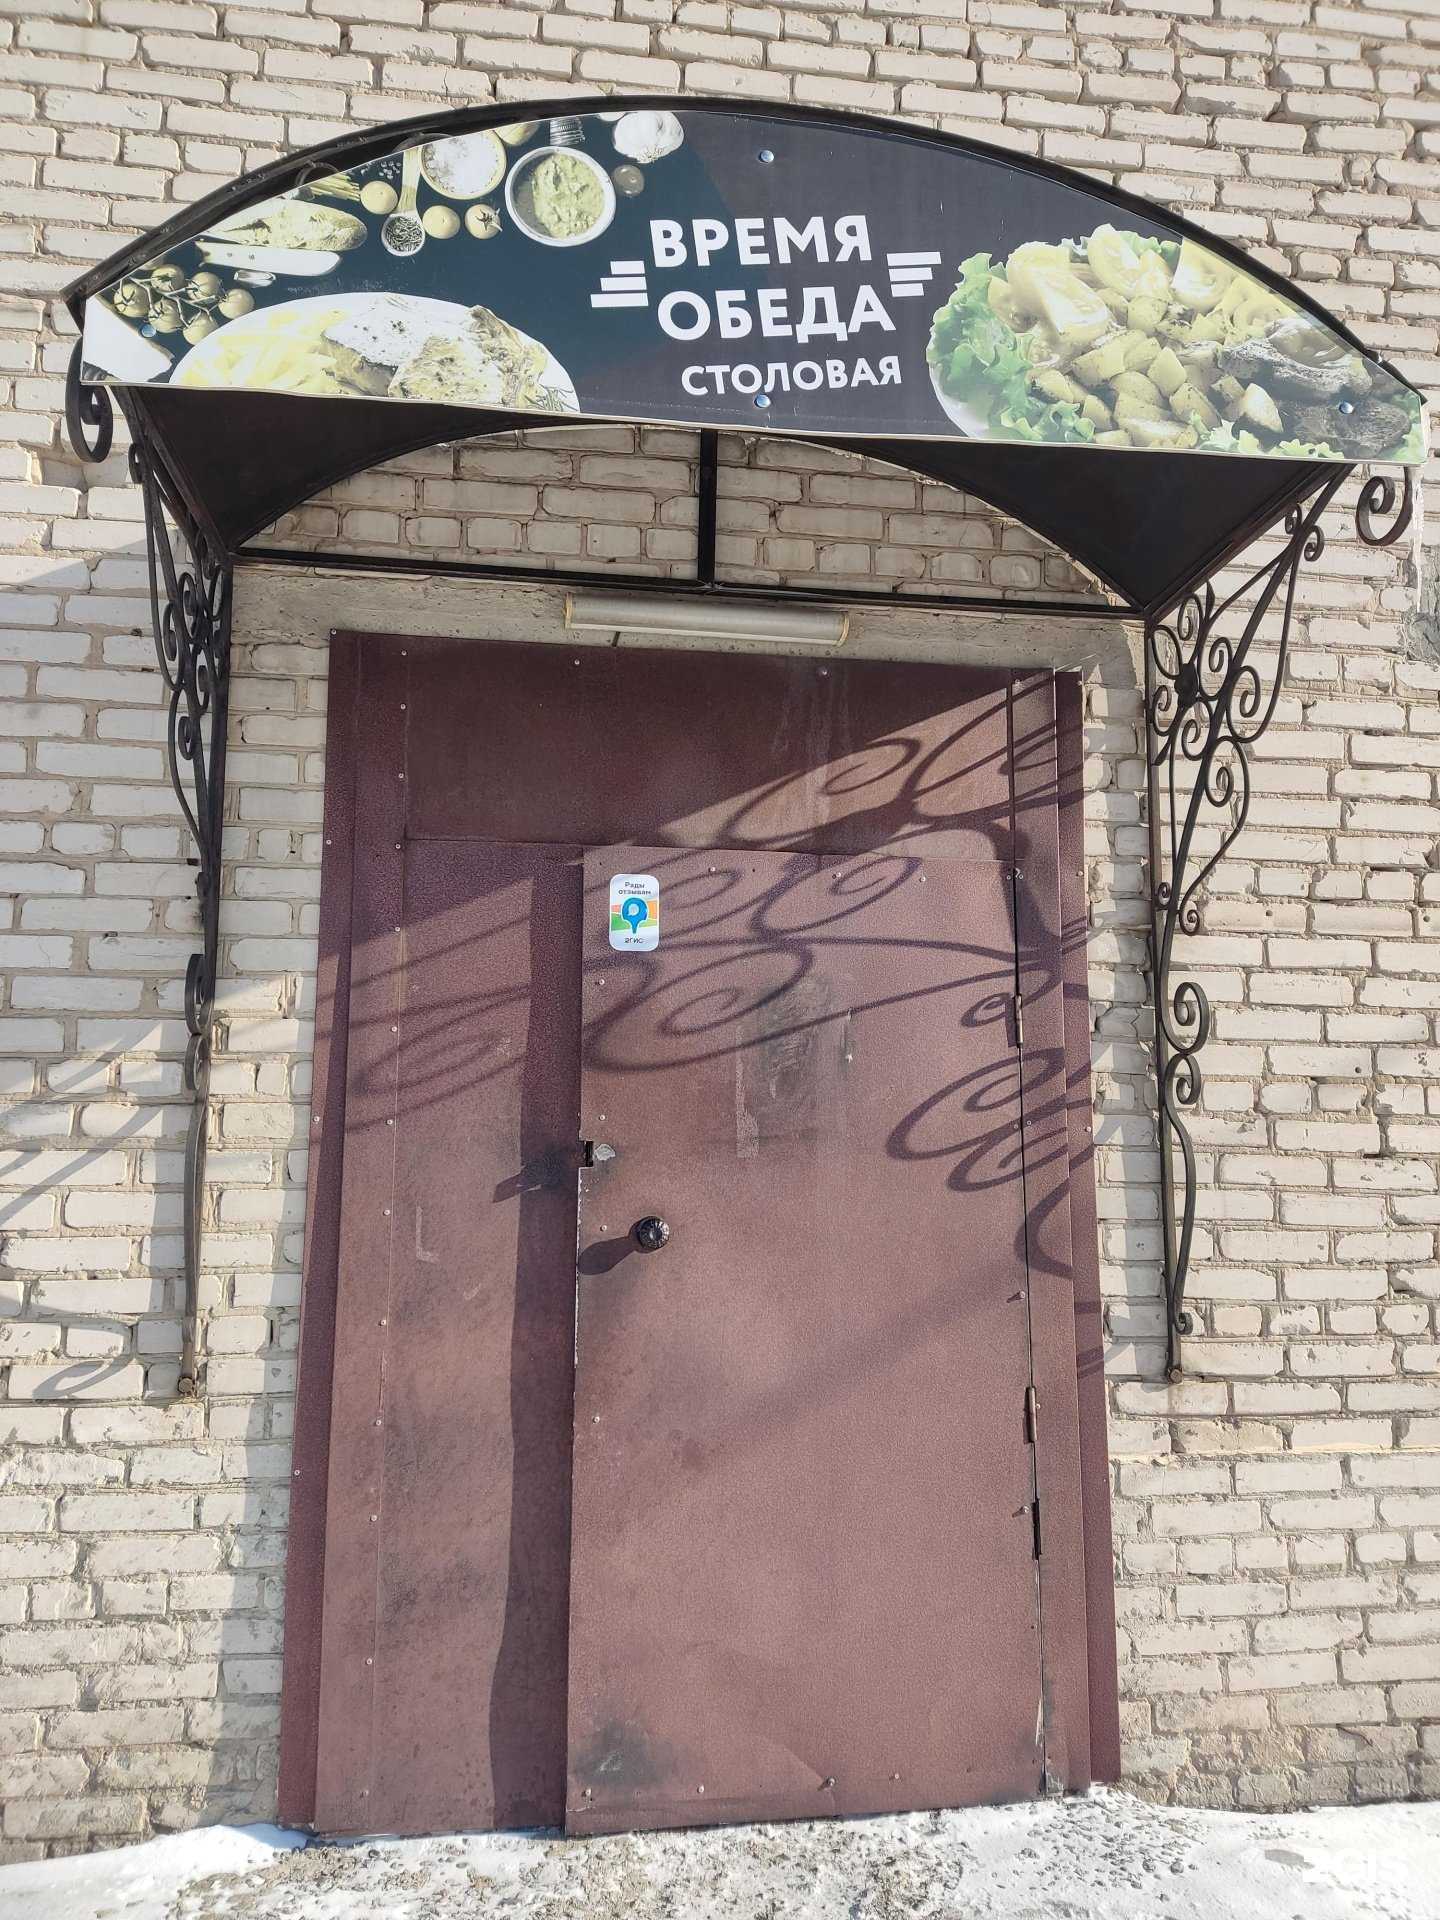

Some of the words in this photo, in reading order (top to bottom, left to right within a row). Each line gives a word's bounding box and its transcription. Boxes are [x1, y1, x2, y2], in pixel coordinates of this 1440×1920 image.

[649, 214, 872, 268] ВРЕМЯ
[657, 284, 896, 344] ОБЕДА
[681, 355, 902, 396] СТОЛОВАЯ
[624, 881, 646, 889] Рады
